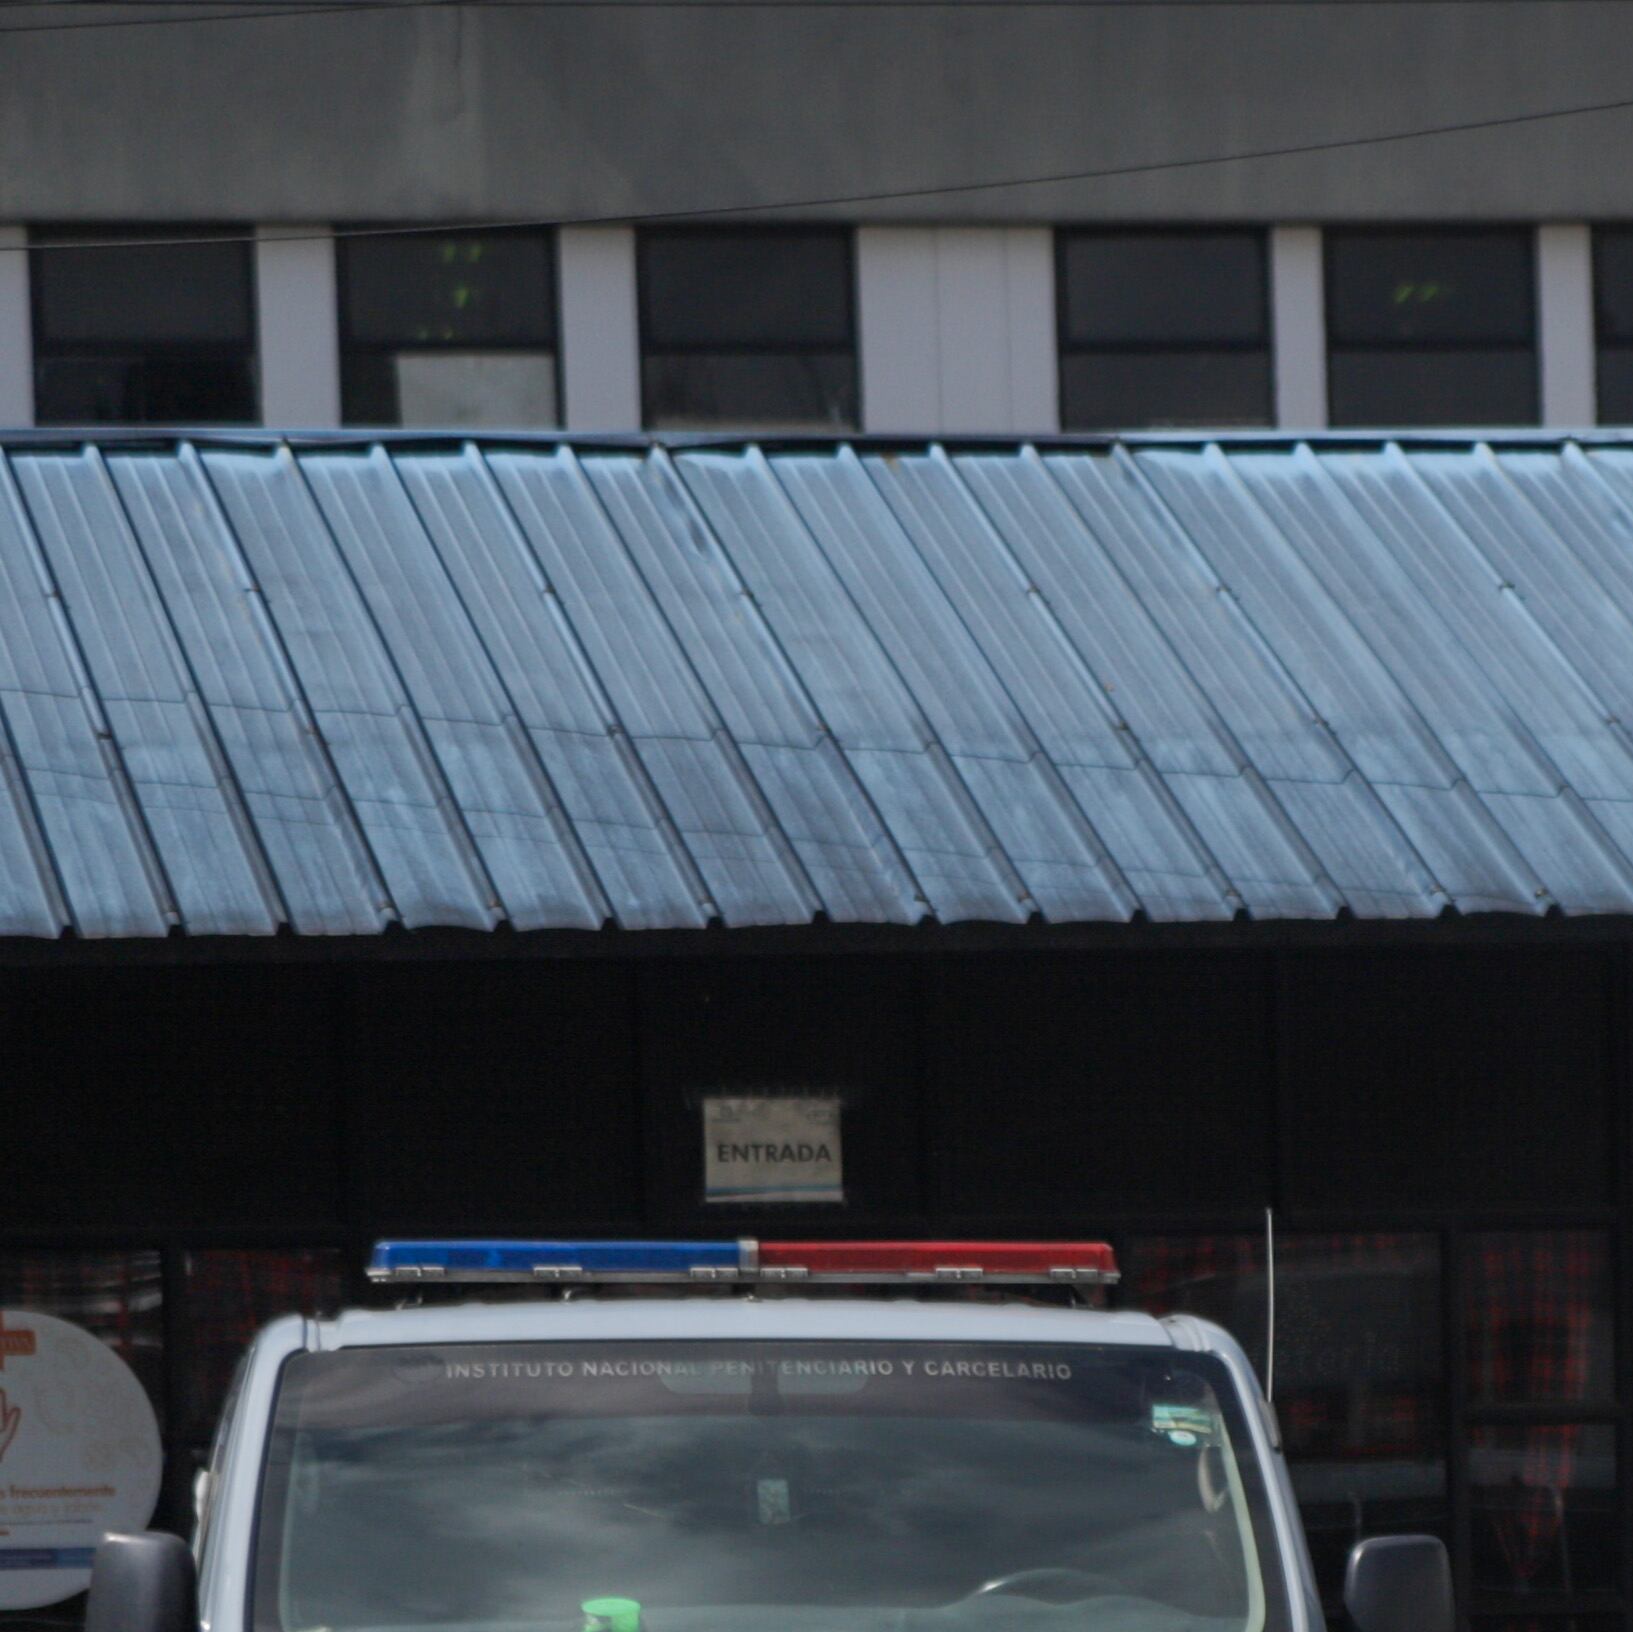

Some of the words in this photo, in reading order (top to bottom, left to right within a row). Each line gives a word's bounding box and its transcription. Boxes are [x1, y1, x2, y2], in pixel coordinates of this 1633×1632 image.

[717, 1144, 832, 1163] ENTRADA
[446, 1361, 574, 1379] INSTITUTO
[581, 1360, 699, 1377] NACIONAL
[709, 1359, 894, 1376] PENITENCIARIO
[902, 1360, 916, 1376] Y
[924, 1360, 1072, 1380] CARCELARIO
